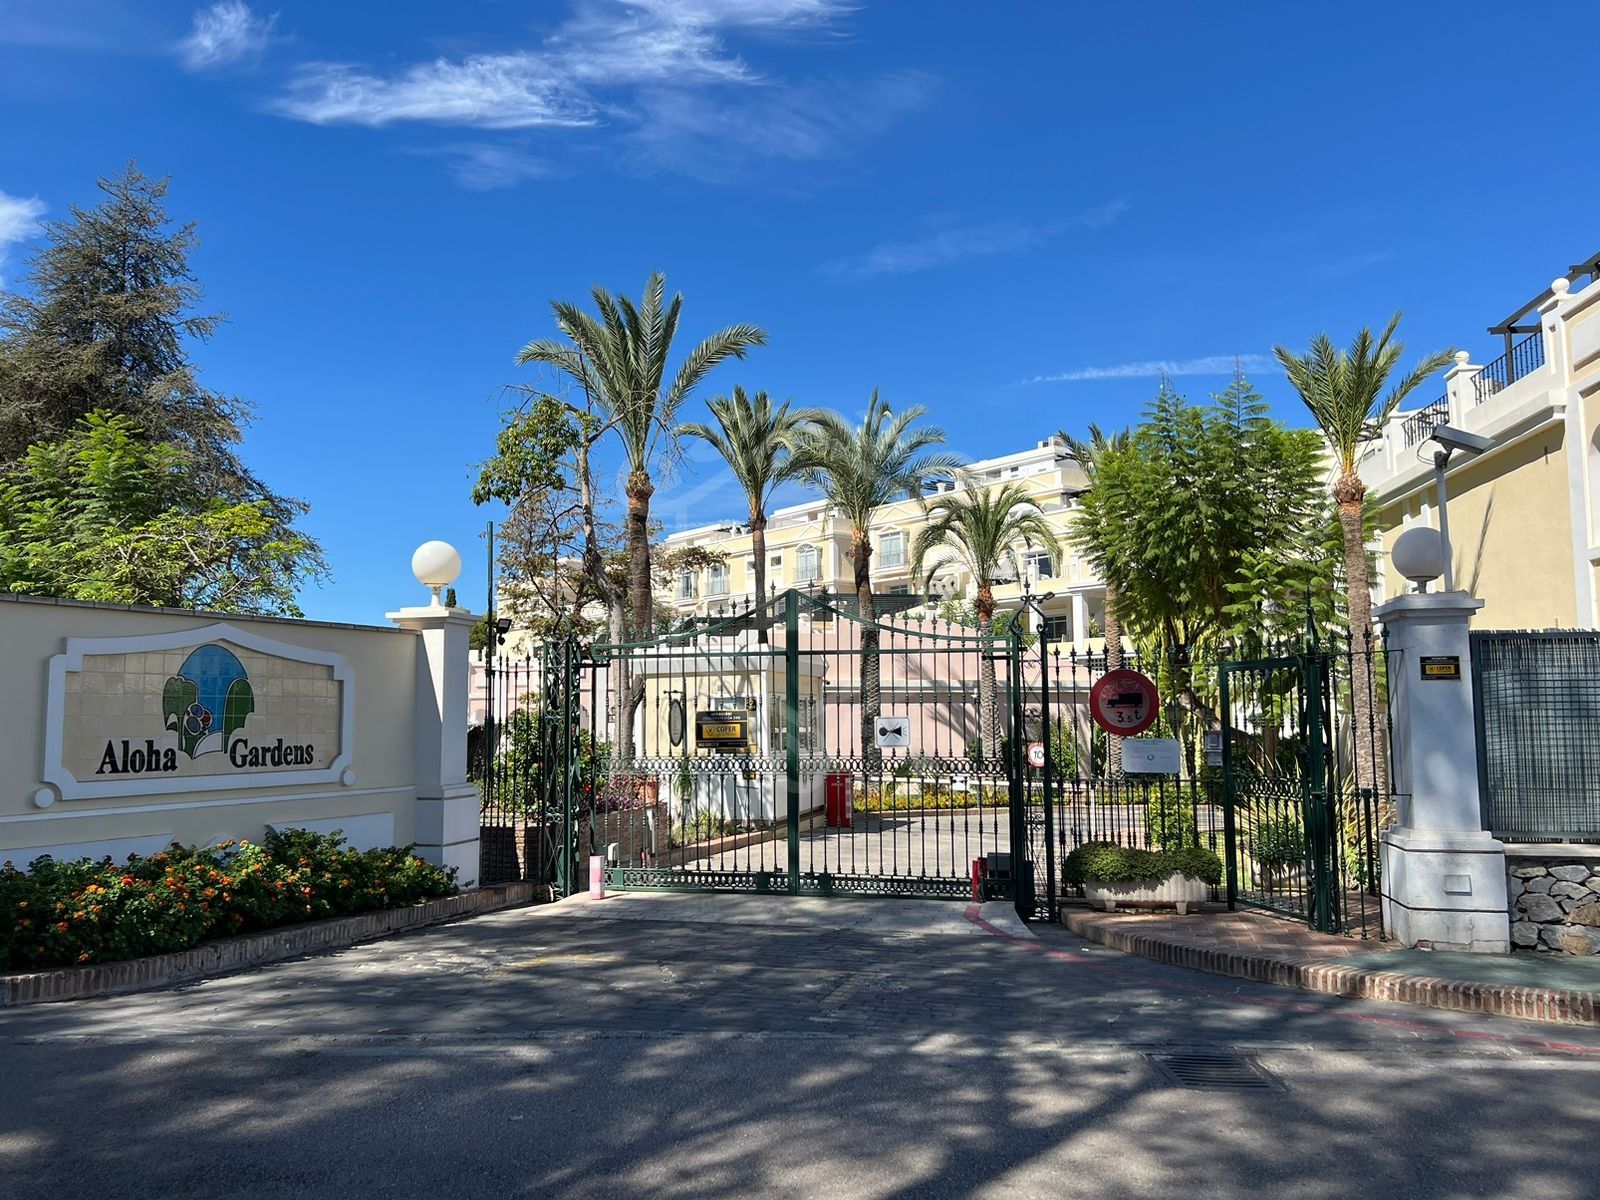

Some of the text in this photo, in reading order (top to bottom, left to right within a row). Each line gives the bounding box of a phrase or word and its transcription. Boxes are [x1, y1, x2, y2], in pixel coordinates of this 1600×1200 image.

[716, 725, 737, 733] COFER
[95, 738, 314, 774] Aloha Gardens
[1033, 750, 1044, 760] 10
